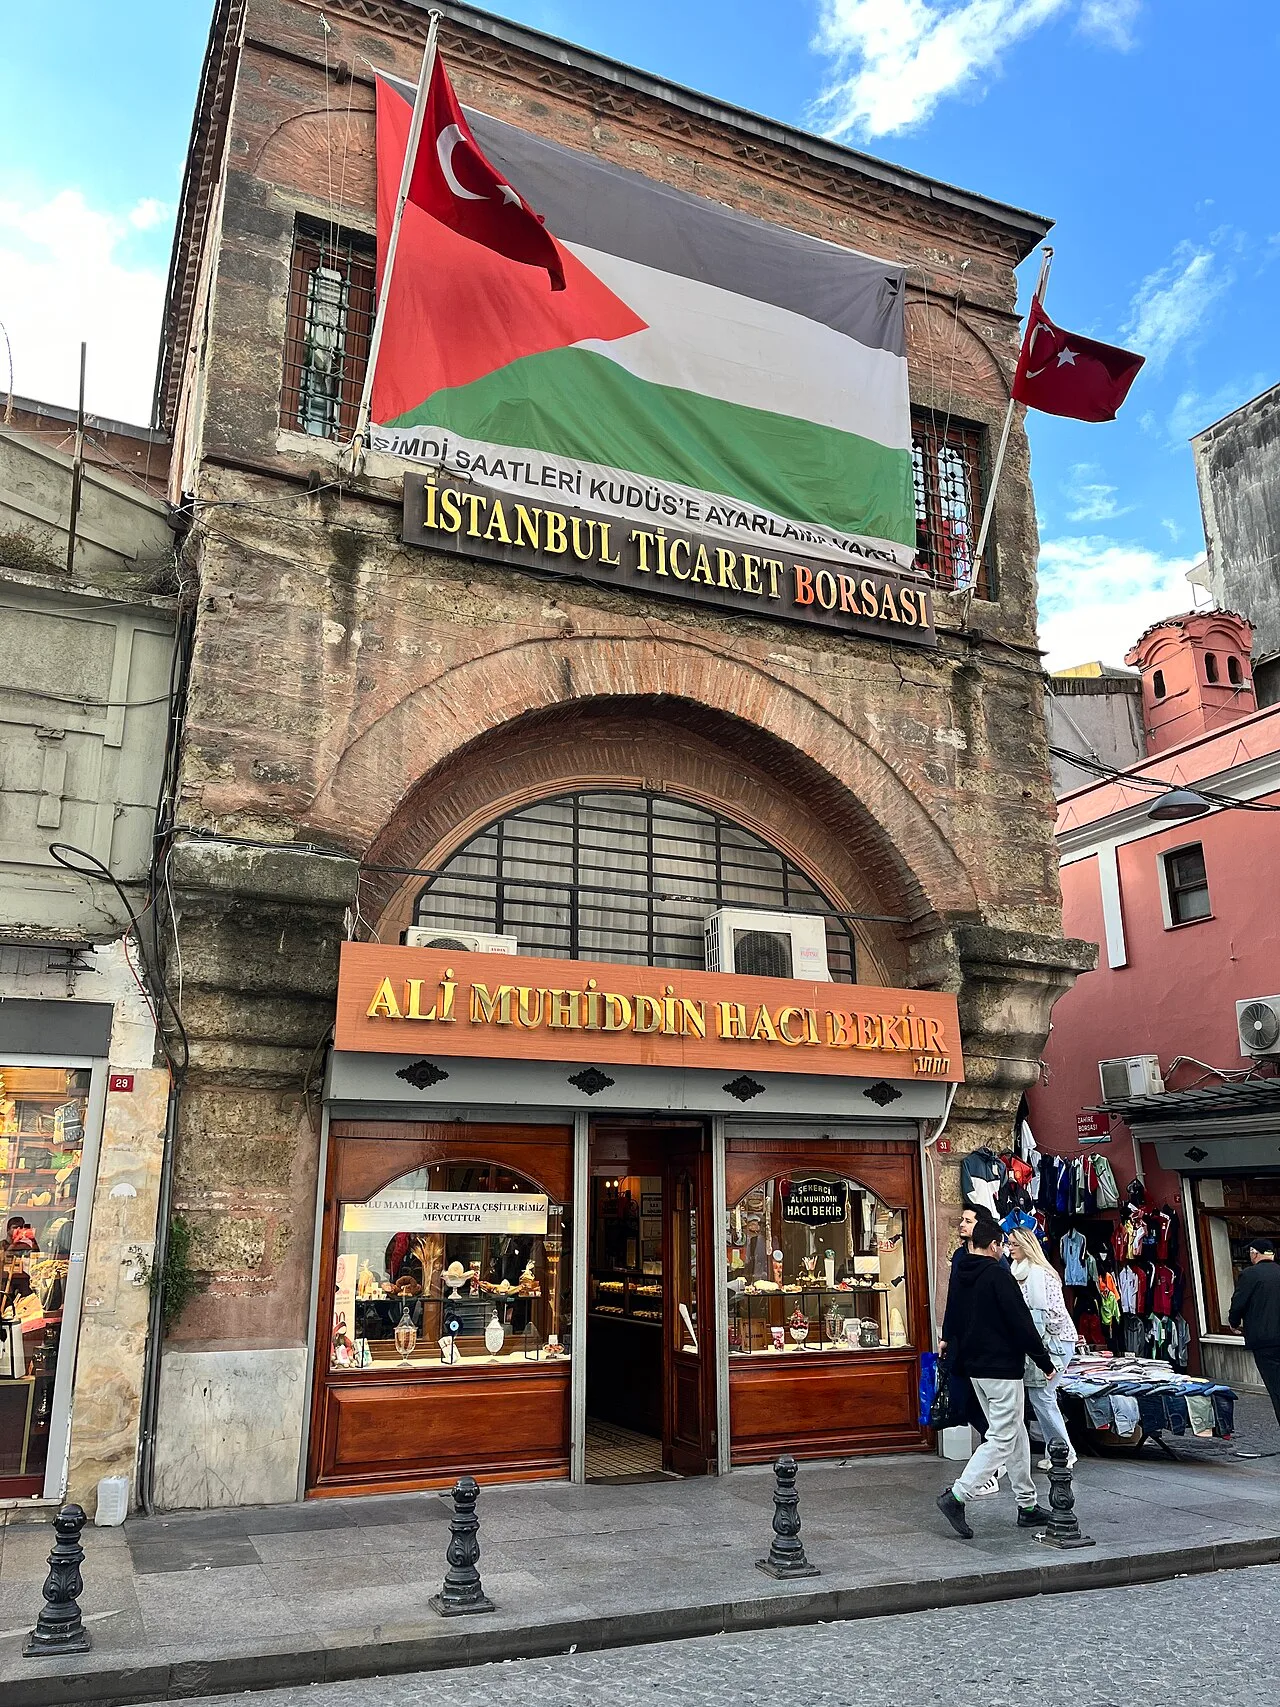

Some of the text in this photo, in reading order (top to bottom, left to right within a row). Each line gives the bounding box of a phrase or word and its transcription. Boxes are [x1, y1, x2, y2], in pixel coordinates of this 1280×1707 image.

[373, 436, 448, 462] ŞİMDİ
[455, 450, 582, 495] SAATLERİ
[589, 478, 701, 521] KUDÜS’E
[423, 477, 931, 628] İSTANBUL TİCARET BORSASI
[366, 968, 951, 1053] ALİ MUHİDDİN HACI BEKİR
[914, 1056, 951, 1074] 1777
[940, 1141, 948, 1150] 31
[383, 1200, 440, 1210] MAMÜLLER
[451, 1202, 480, 1211] PASTA
[482, 1201, 545, 1213] ÇEŞİTLERİMİZ
[787, 1203, 842, 1216] HACI BEKİR
[422, 1213, 482, 1222] MEVCUTTUR
